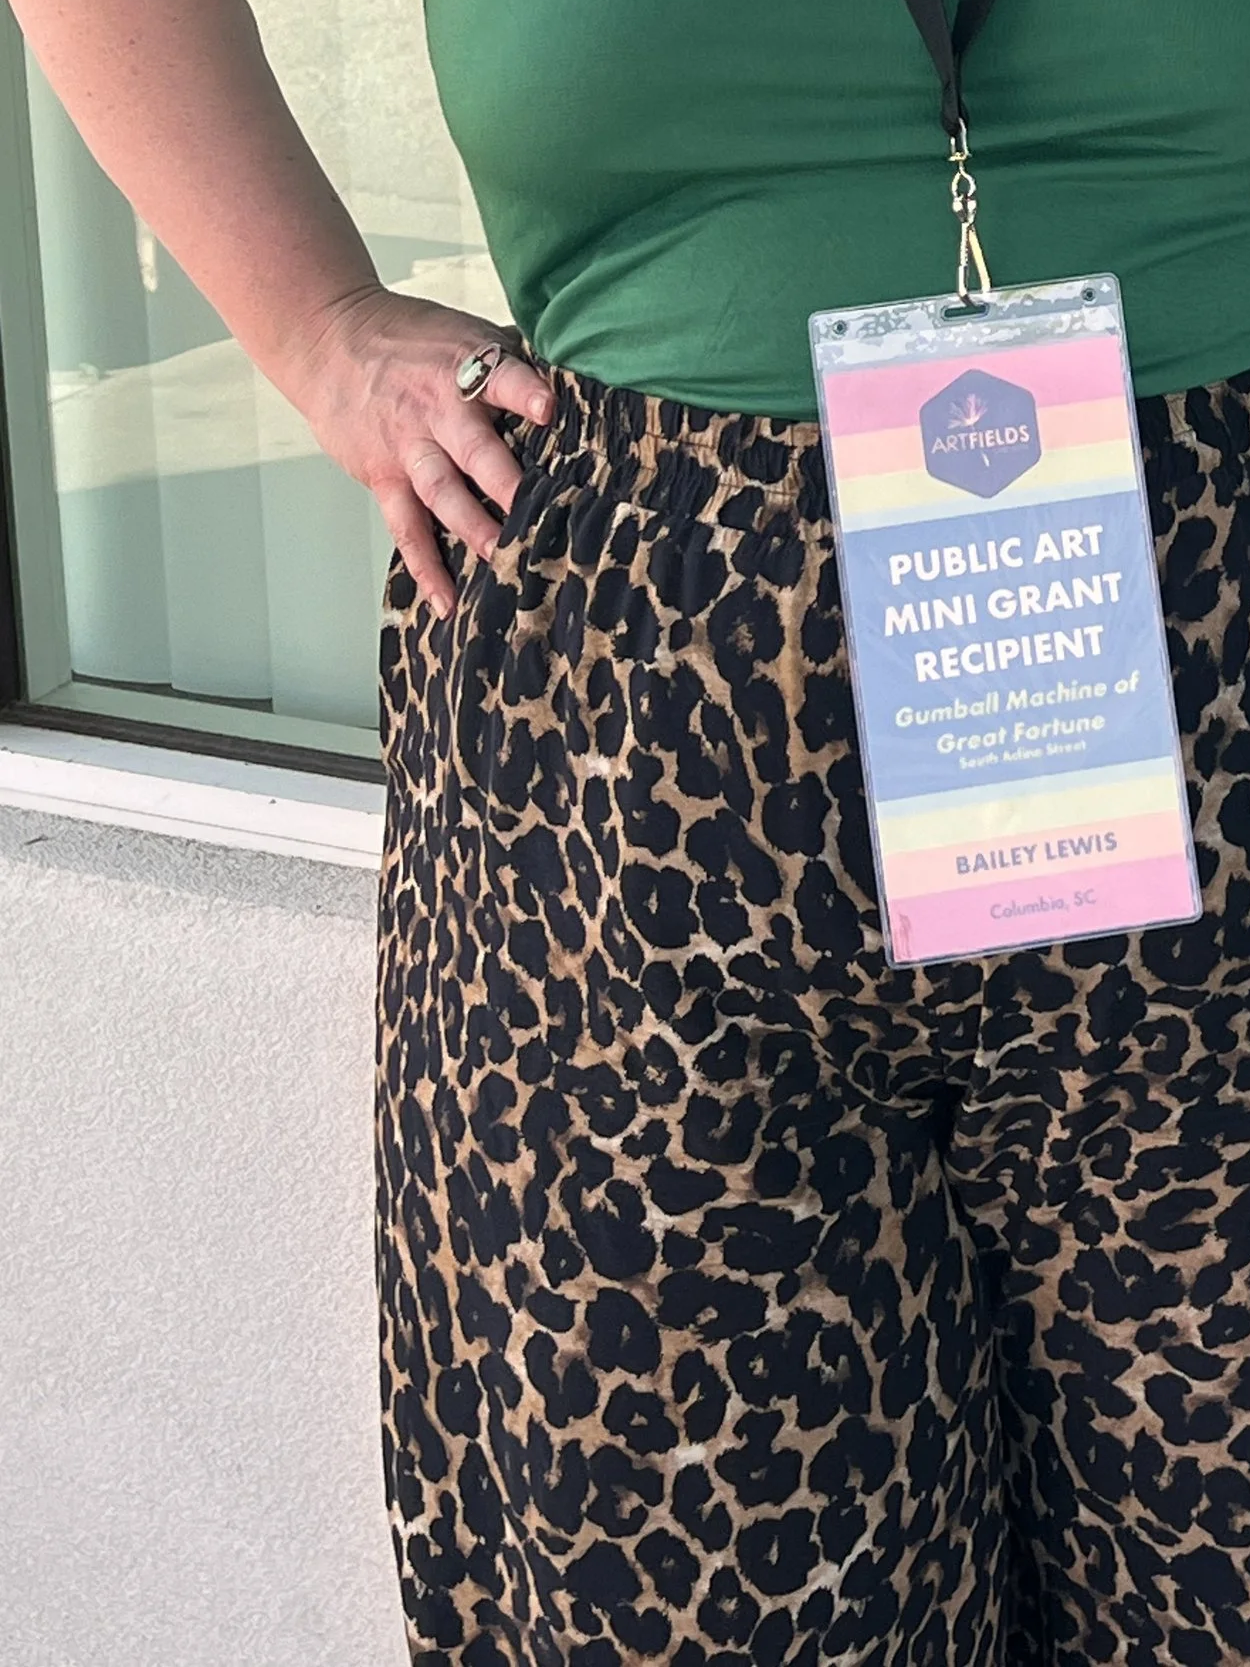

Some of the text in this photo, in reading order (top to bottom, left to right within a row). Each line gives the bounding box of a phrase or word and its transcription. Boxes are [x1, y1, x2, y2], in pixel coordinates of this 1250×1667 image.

[931, 424, 1030, 454] ARTFIELDS
[889, 524, 1103, 585] PUBLIC ART
[884, 572, 1122, 637] MINI GRANT
[914, 625, 1104, 683] RECIPIENT
[895, 670, 1140, 728] Gumball Machine of
[936, 714, 1106, 754] Great Fortune
[959, 751, 999, 770] South
[1046, 739, 1086, 756] Street
[955, 831, 1118, 875] BAILEY LEWIS
[989, 888, 1097, 920] Columbia, SC
